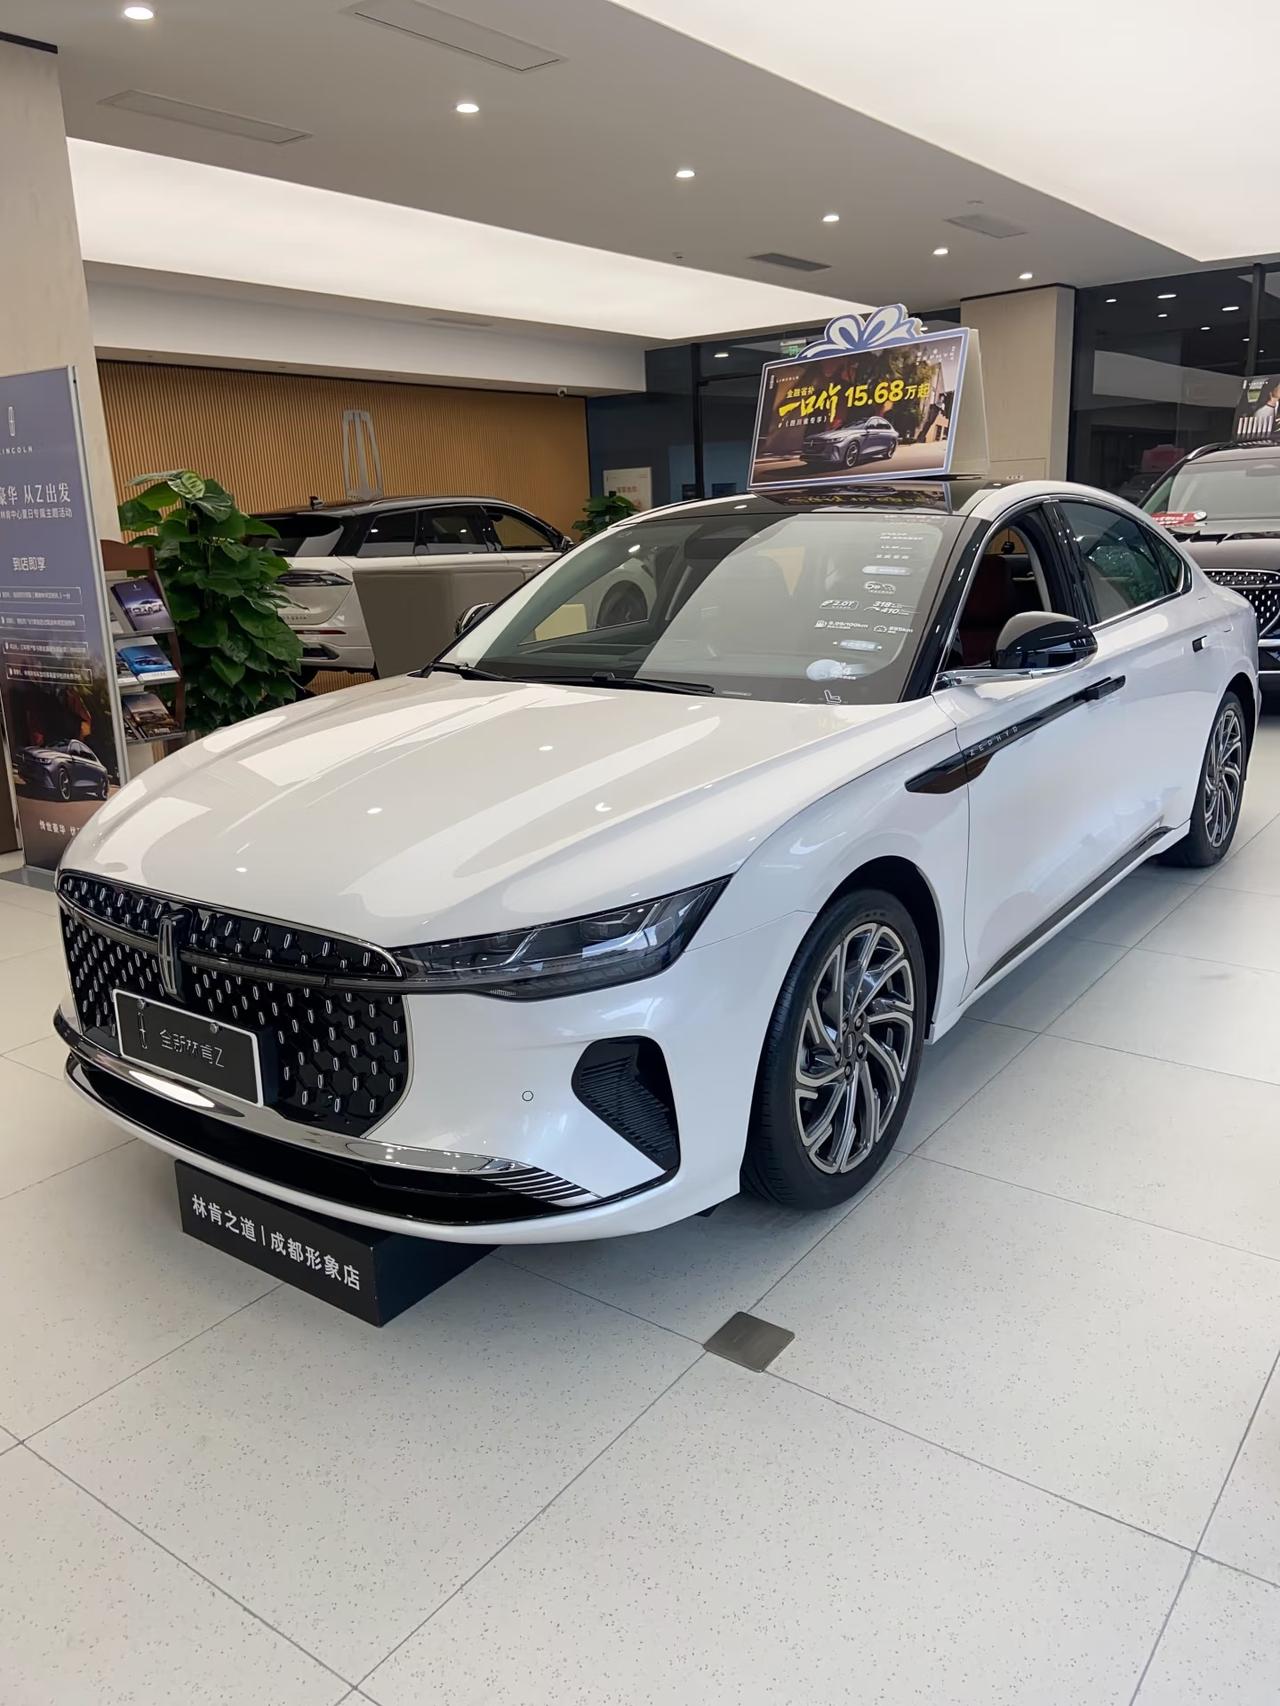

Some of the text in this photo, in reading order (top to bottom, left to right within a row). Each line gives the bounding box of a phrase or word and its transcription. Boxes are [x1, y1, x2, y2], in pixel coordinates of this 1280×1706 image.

[778, 383, 842, 423] 一口价
[23, 482, 71, 504] 从Z出发
[12, 556, 47, 571] 到店即享
[160, 1029, 225, 1068] 全新林肯Z
